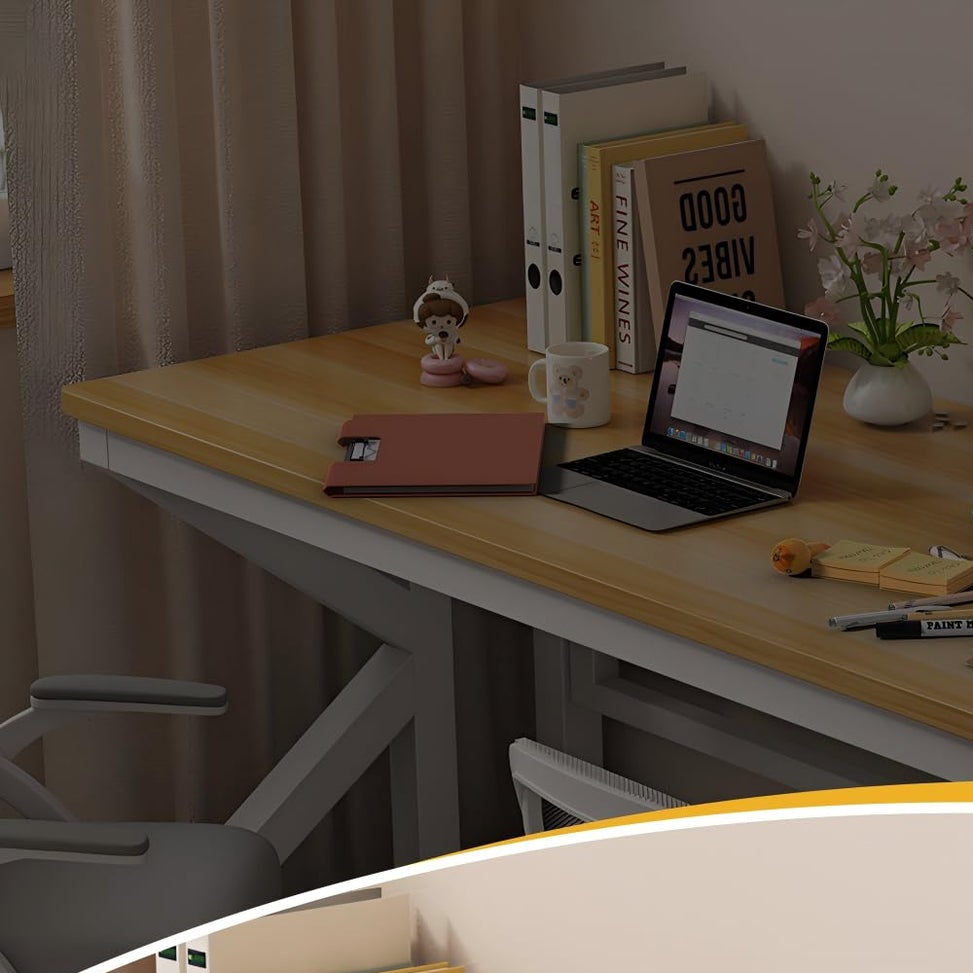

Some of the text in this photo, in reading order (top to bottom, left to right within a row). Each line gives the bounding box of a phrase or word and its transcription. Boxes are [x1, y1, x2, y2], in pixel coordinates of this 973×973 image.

[590, 199, 600, 236] ART
[615, 195, 629, 252] FINE
[615, 263, 631, 346] WINES
[926, 620, 963, 630] PAINT
